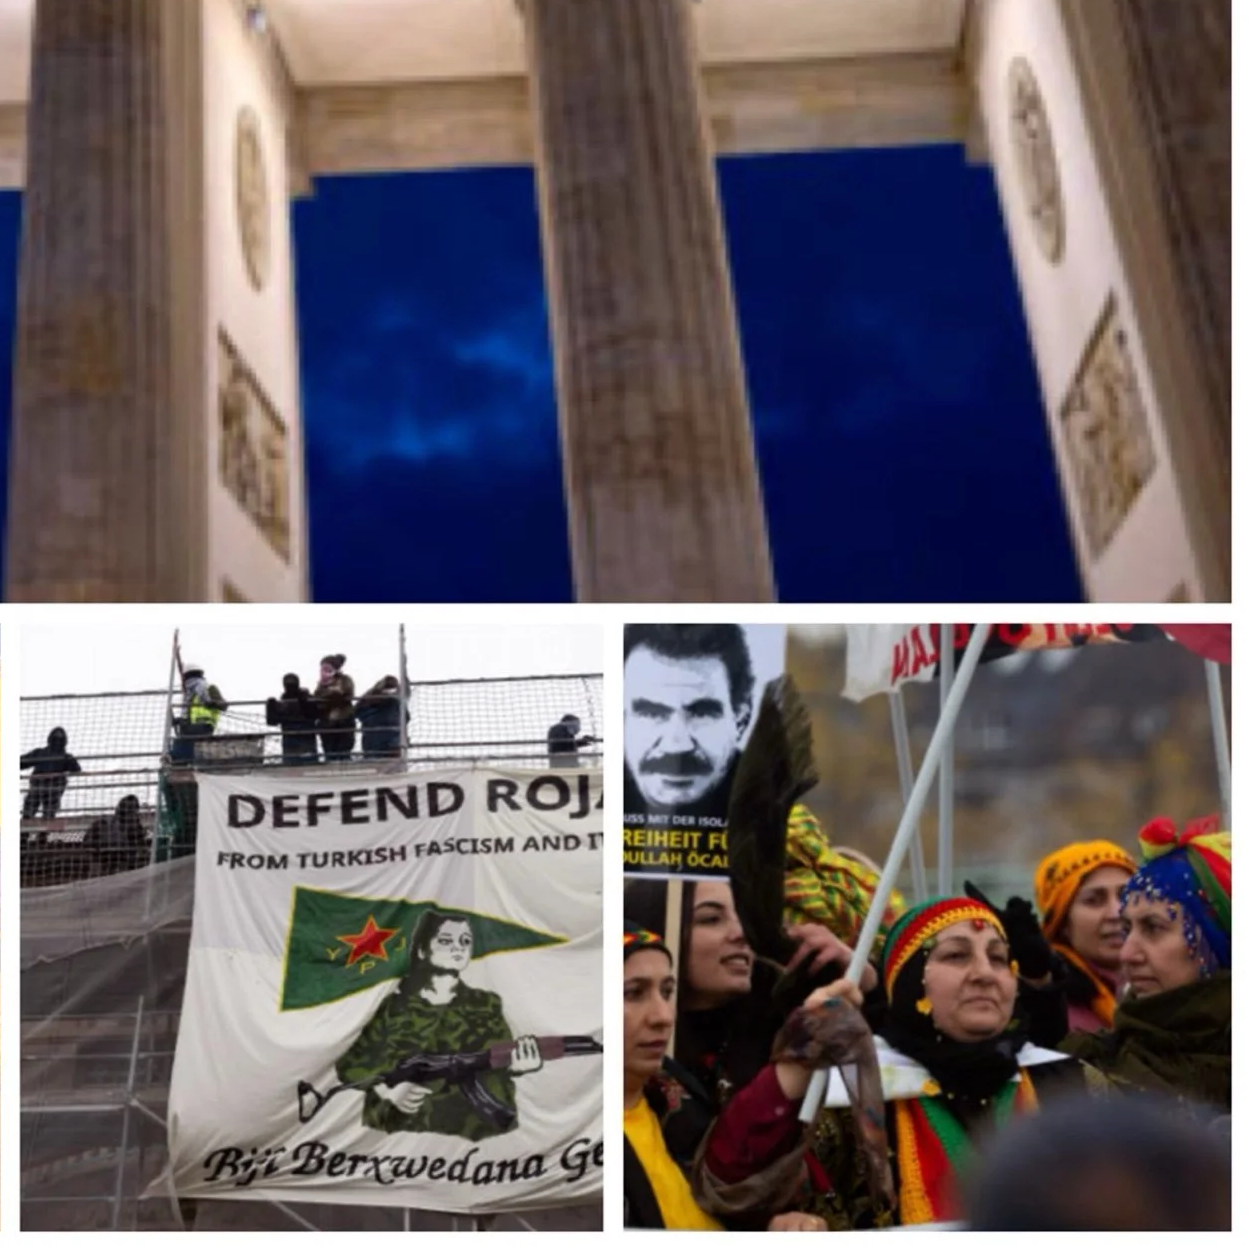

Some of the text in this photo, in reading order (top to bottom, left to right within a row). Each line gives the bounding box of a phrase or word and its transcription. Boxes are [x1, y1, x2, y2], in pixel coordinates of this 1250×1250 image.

[226, 781, 466, 829] DEFEND
[648, 814, 669, 825] MIT
[672, 815, 696, 827] DER
[217, 851, 288, 871] FROM
[297, 845, 407, 869] TURKISH
[414, 836, 515, 859] FASCISM
[522, 833, 582, 852] AND
[325, 947, 343, 961] Y
[358, 961, 376, 975] P
[291, 1139, 548, 1185] Berxwedana
